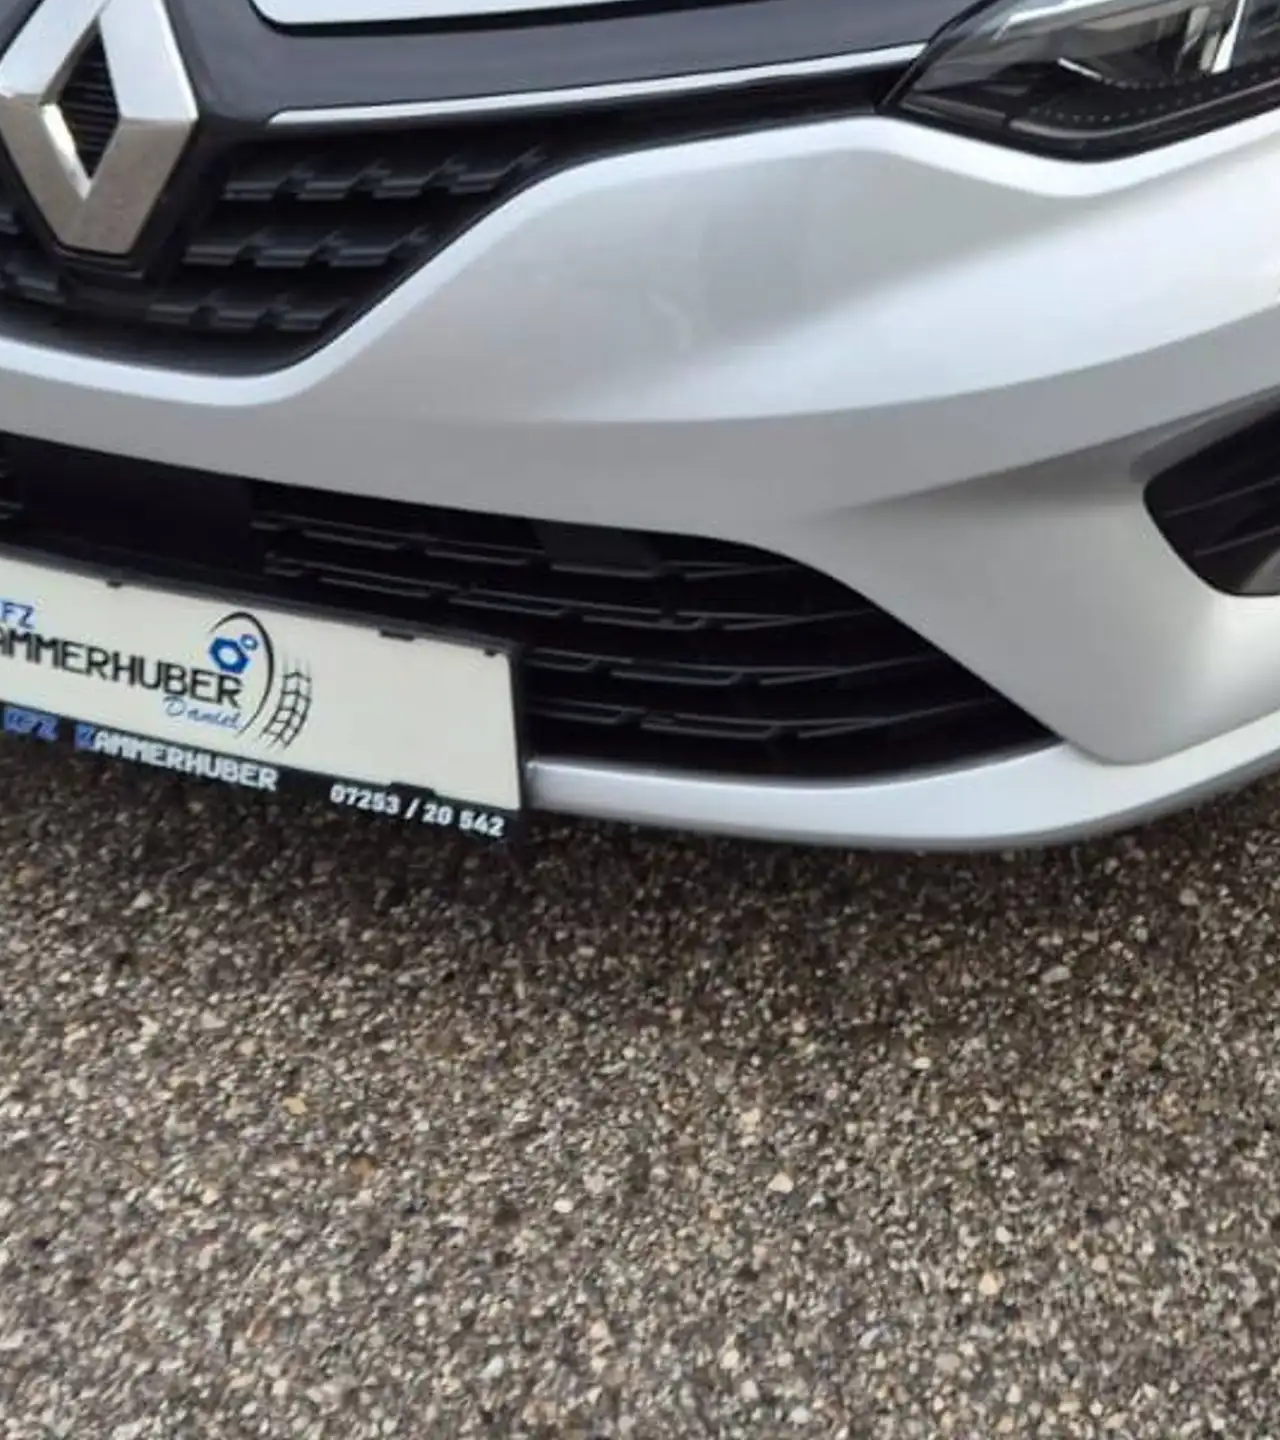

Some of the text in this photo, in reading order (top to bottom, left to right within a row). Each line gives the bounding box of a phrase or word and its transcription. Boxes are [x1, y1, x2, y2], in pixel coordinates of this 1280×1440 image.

[3, 704, 58, 742] KFZ
[329, 783, 401, 815] 07253
[404, 797, 420, 821] /
[422, 802, 453, 827] 20
[458, 809, 505, 838] 542
